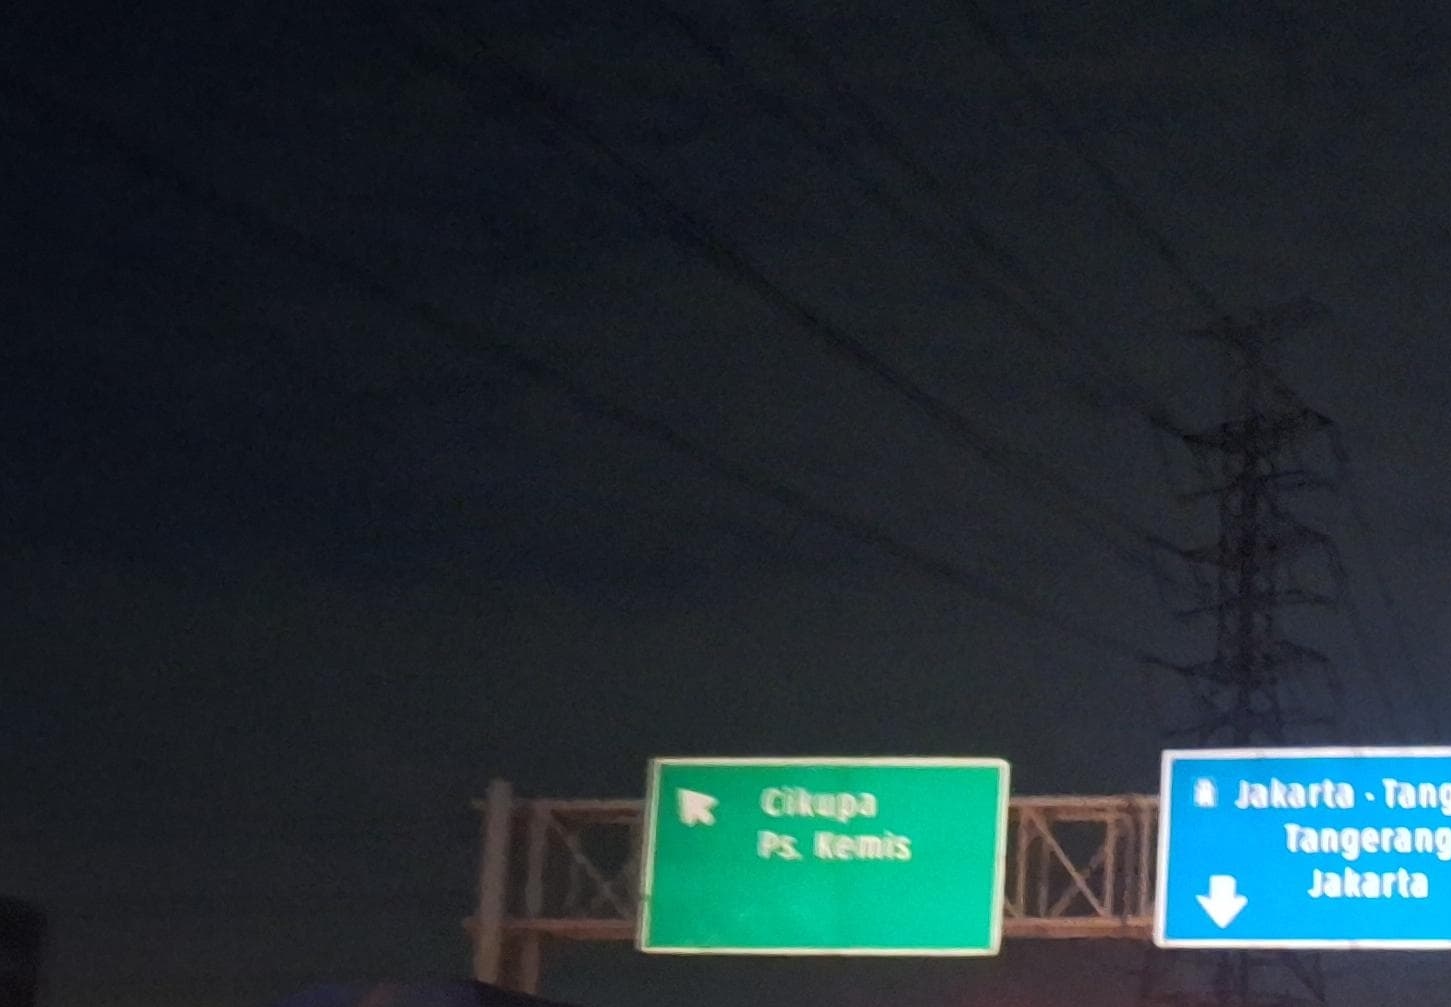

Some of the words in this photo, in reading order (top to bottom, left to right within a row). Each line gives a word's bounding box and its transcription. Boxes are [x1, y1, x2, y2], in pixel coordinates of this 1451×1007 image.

[761, 787, 877, 822] Cikupa
[1236, 778, 1355, 809] Jakarta
[814, 829, 912, 861] Kemis
[1307, 866, 1429, 899] Jakarta
